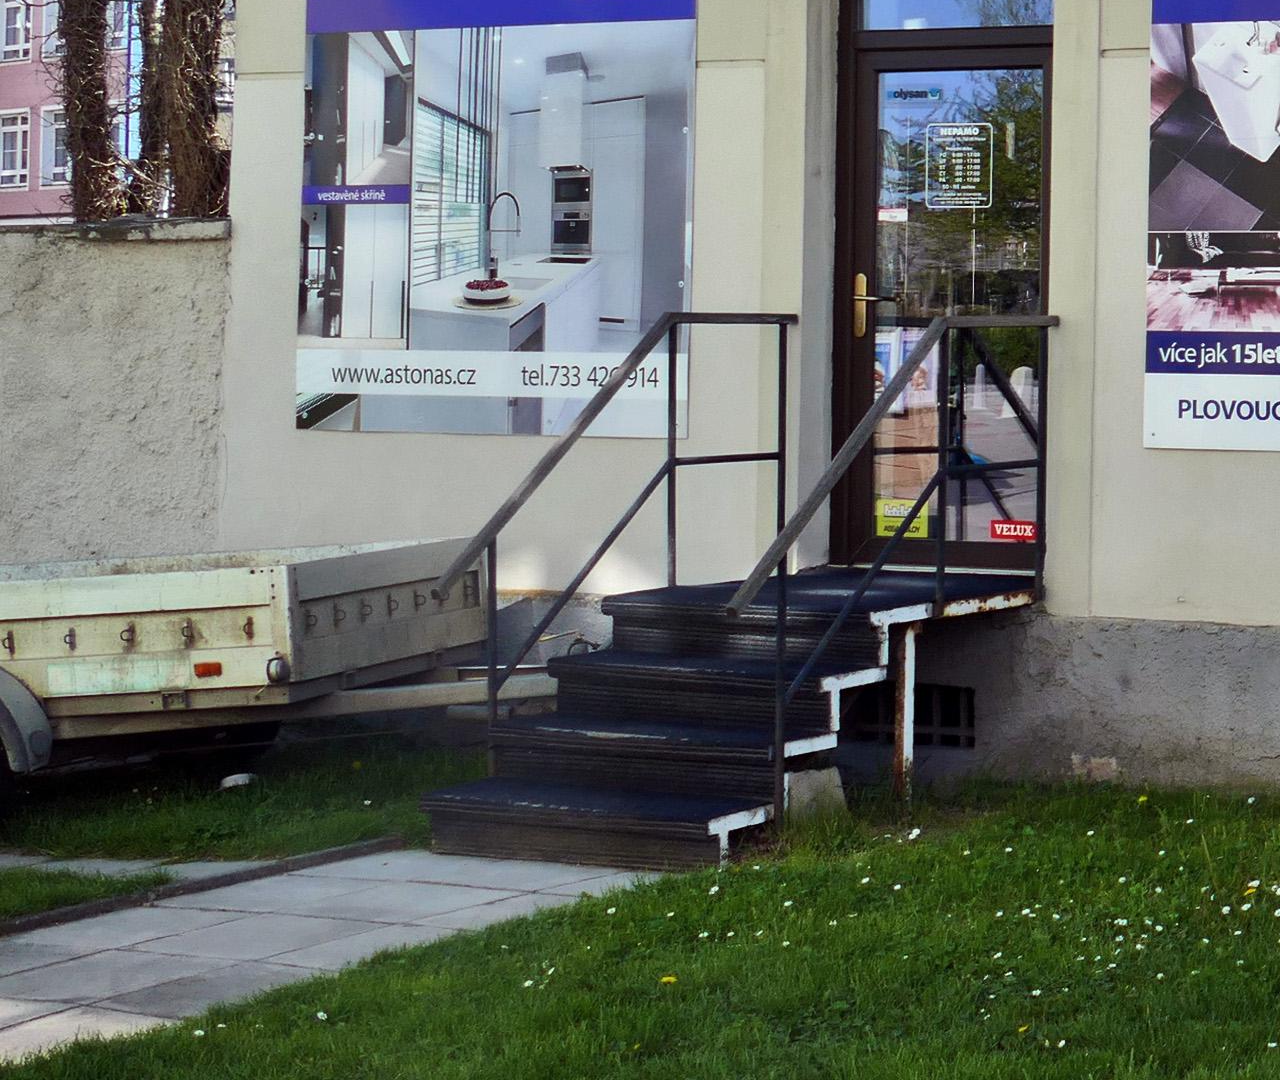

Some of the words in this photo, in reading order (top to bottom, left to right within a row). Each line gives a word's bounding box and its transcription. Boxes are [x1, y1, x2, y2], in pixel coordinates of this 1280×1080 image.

[1159, 343, 1197, 364] více
[1197, 343, 1228, 368] jak
[331, 365, 477, 386] www.astonas.cz
[521, 364, 581, 386] tel.733
[587, 366, 621, 387] 42
[627, 367, 660, 388] 914
[994, 523, 1033, 536] VELUX
